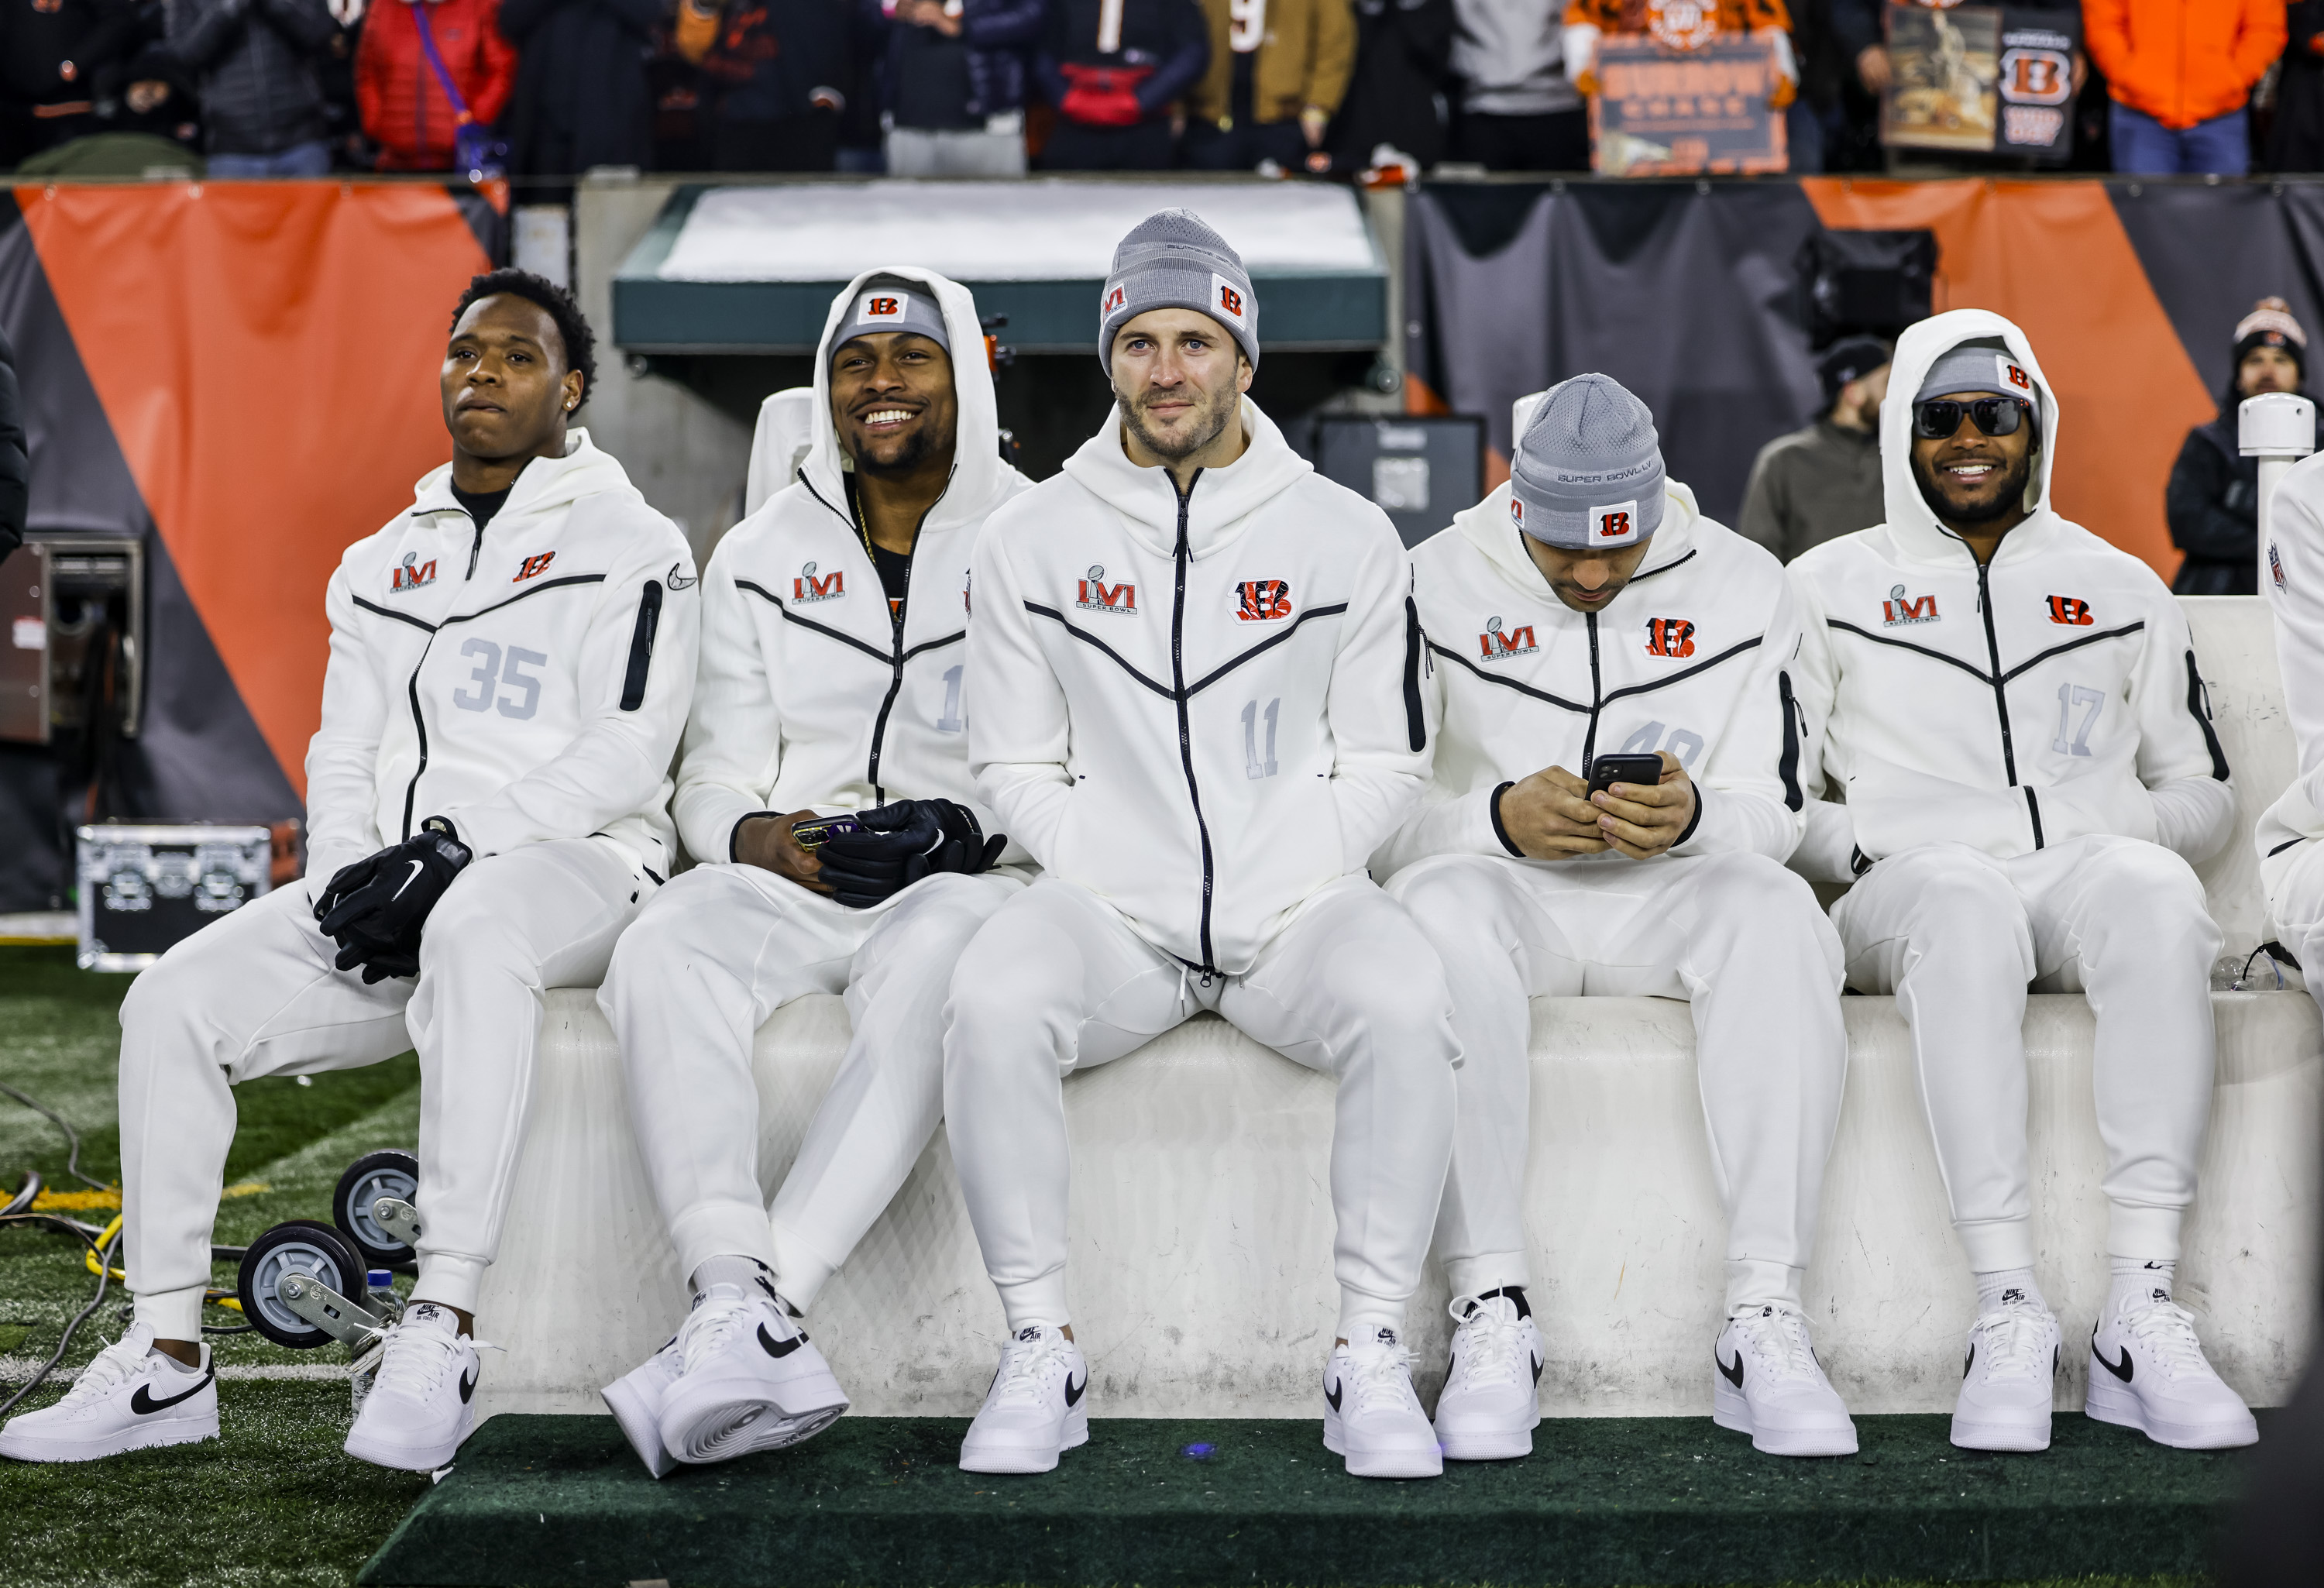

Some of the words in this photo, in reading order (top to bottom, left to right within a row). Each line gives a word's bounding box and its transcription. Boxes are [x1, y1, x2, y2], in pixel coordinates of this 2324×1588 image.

[868, 298, 898, 315] B
[1221, 285, 1242, 317] B
[2007, 364, 2030, 390] B
[1558, 475, 1602, 483] SUPER
[1607, 468, 1641, 481] BOWL
[1600, 512, 1630, 537] B
[394, 559, 437, 589] LVI
[513, 551, 556, 583] B
[794, 571, 843, 599] LVI
[1078, 579, 1136, 608] LVI
[1235, 580, 1292, 620] B
[1883, 595, 1937, 621] LVI
[2045, 595, 2094, 626] B
[1480, 626, 1536, 655] LVI
[1645, 617, 1695, 658] B
[453, 638, 548, 720] 35
[937, 665, 969, 732] 1
[2053, 682, 2106, 757] 17
[1241, 698, 1281, 780] 11
